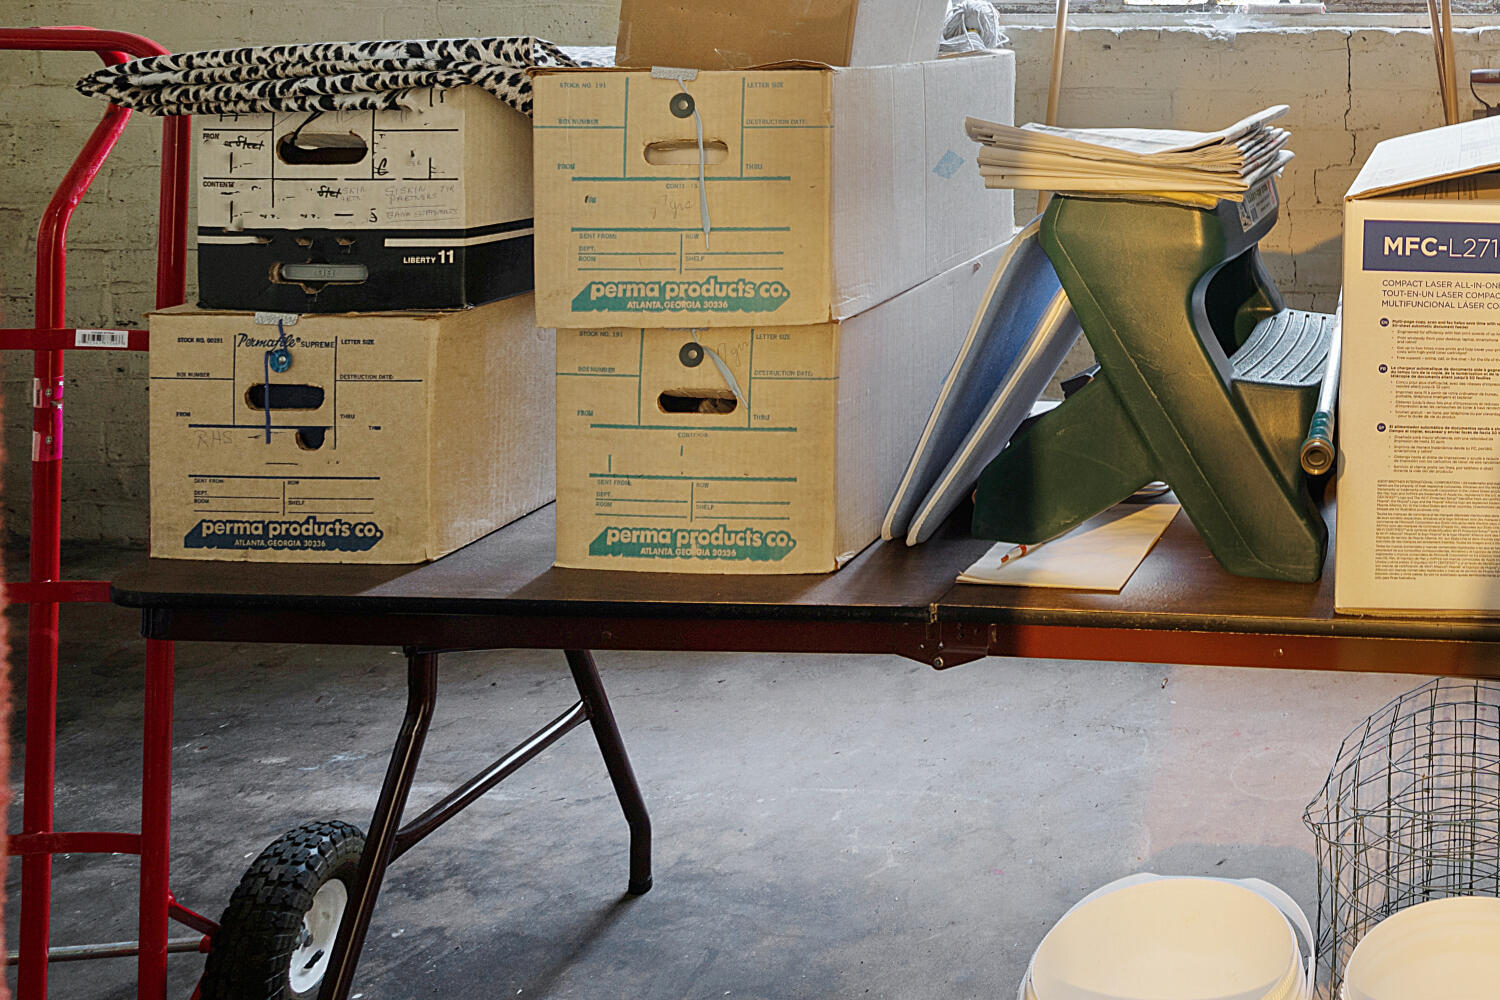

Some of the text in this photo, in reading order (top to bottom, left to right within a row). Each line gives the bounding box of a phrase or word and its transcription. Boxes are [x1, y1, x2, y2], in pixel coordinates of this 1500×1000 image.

[438, 250, 454, 264] 11
[590, 278, 788, 300] perma products co.
[1382, 280, 1422, 288] COMPACT
[1382, 290, 1434, 298] TOUT-EN-UN
[1436, 291, 1463, 299] LASER
[627, 301, 664, 310] ATLANTA,
[1382, 300, 1456, 308] MULTIFUNCIONAL
[1458, 300, 1484, 309] LÁSER
[202, 518, 382, 538] perma products co.
[606, 526, 794, 547] perma products co.
